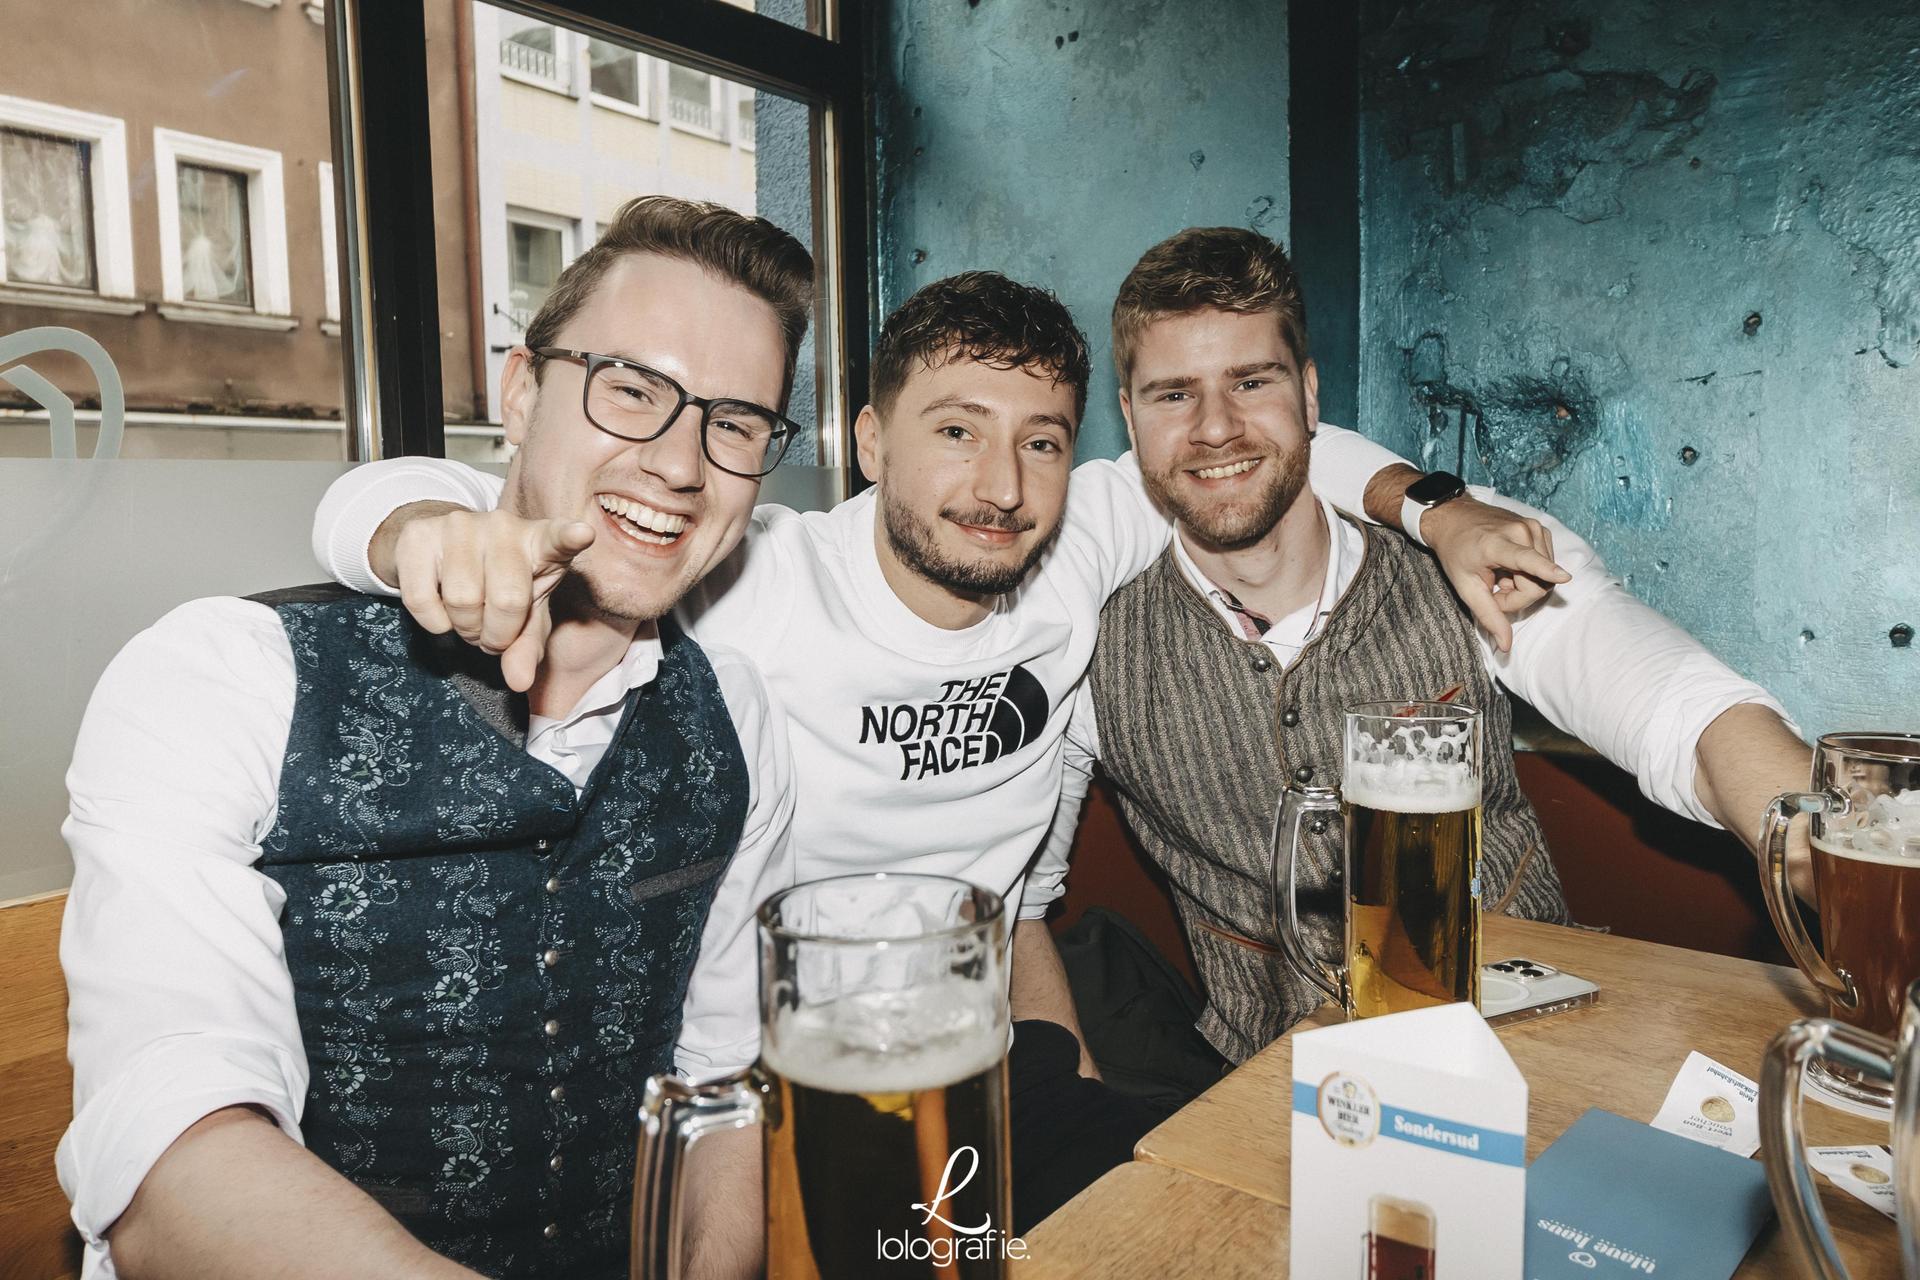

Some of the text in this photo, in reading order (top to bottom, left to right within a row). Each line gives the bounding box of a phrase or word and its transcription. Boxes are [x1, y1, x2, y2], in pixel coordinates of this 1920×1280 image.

[934, 672, 1008, 703] THE
[859, 703, 994, 744] NORTH
[900, 734, 983, 781] FACE
[1394, 1114, 1480, 1152] Sondersud
